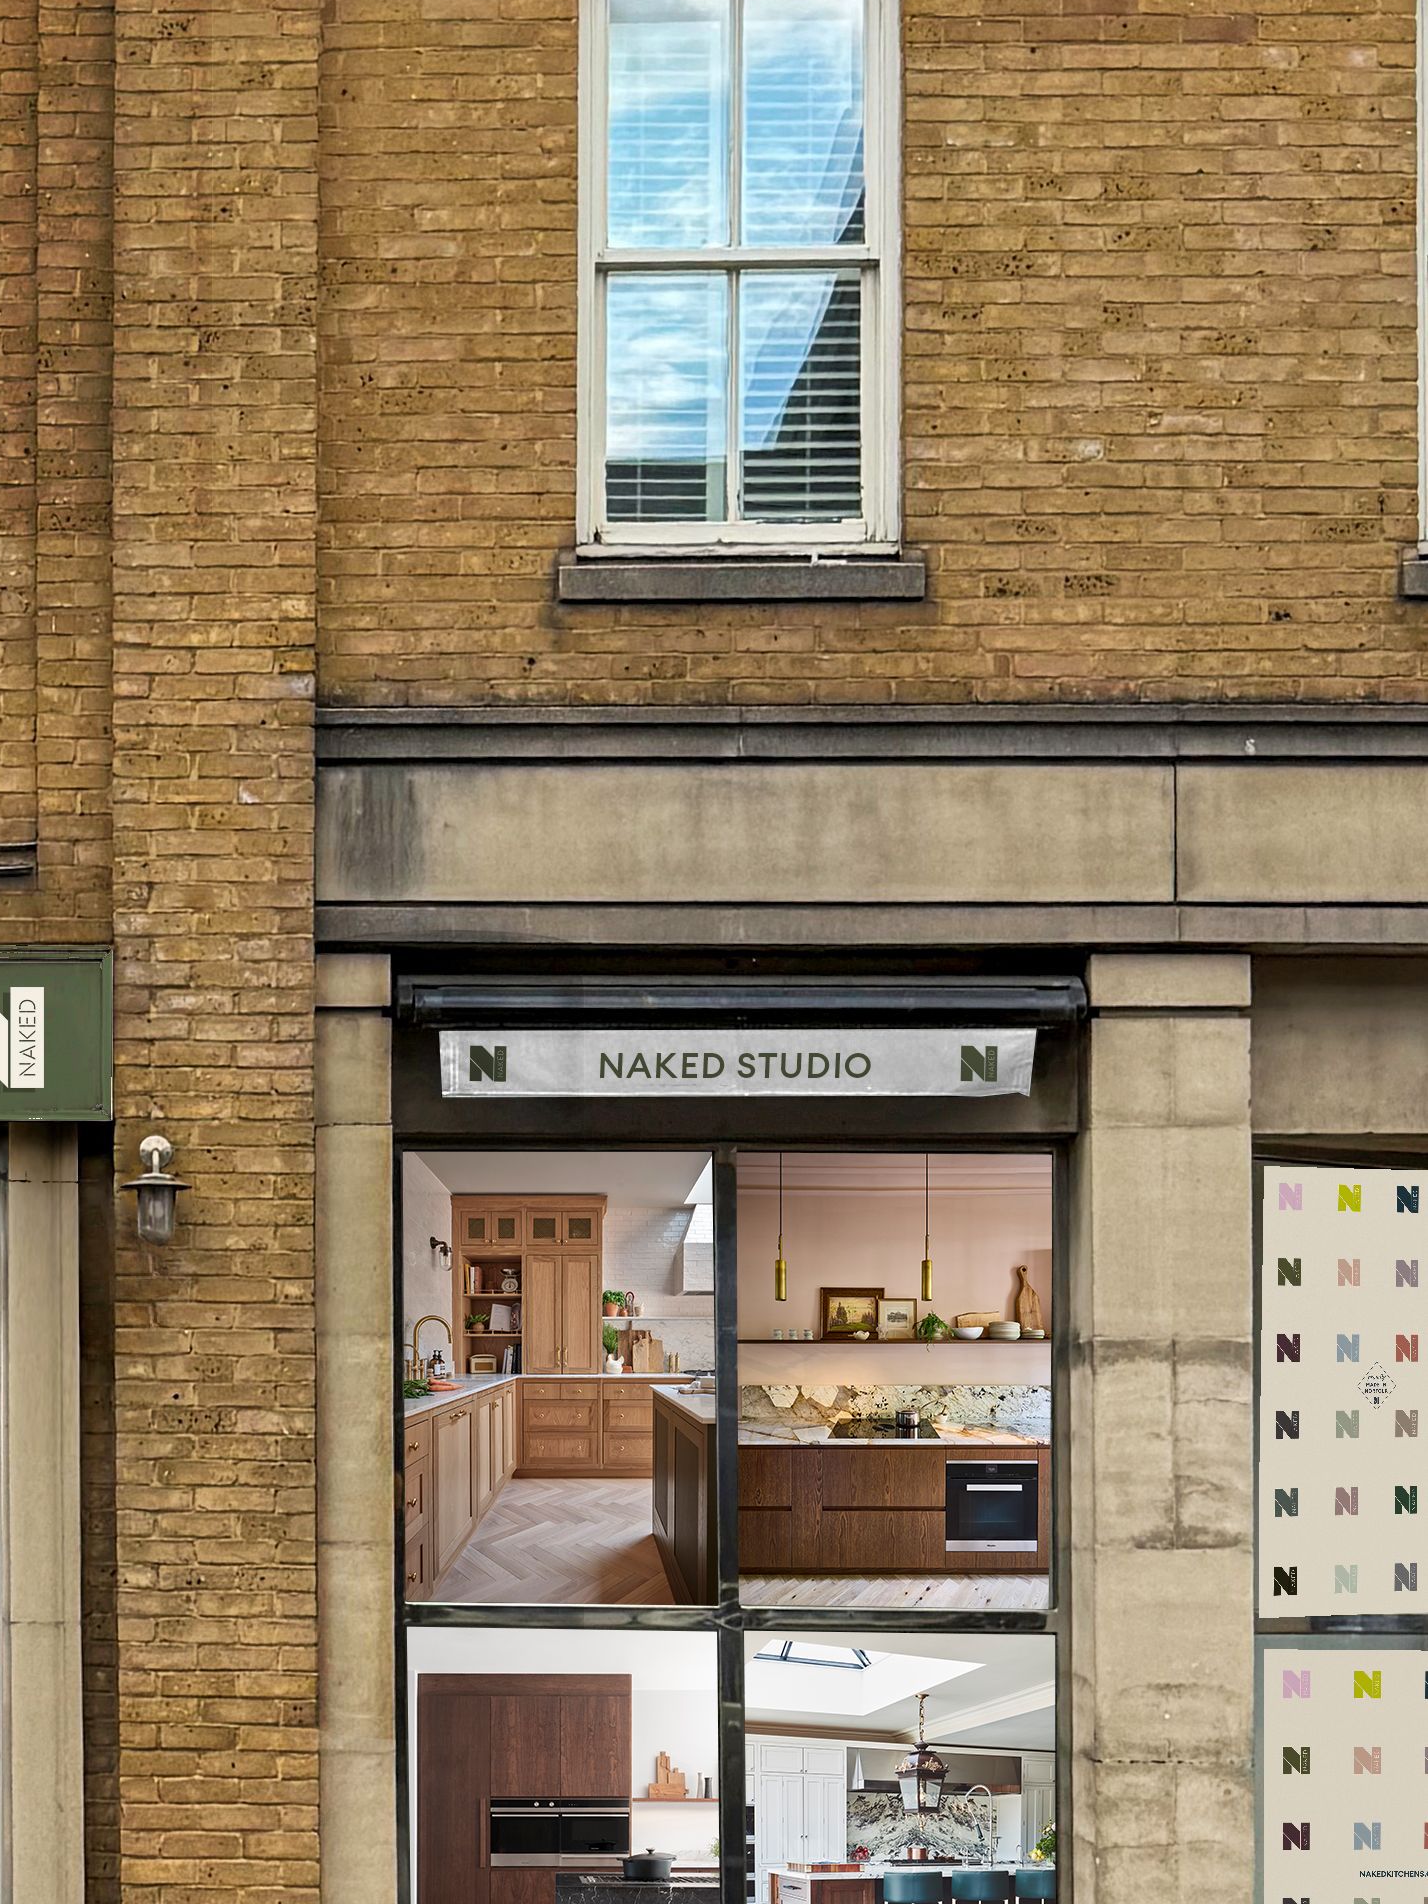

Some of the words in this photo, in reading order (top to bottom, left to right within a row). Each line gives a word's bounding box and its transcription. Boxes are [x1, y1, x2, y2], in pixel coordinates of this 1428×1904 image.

[18, 998, 36, 1077] NAKED
[496, 1050, 505, 1079] NAKED
[599, 1052, 725, 1079] NAKED
[737, 1052, 872, 1079] STUDIO
[987, 1050, 996, 1079] NAKED
